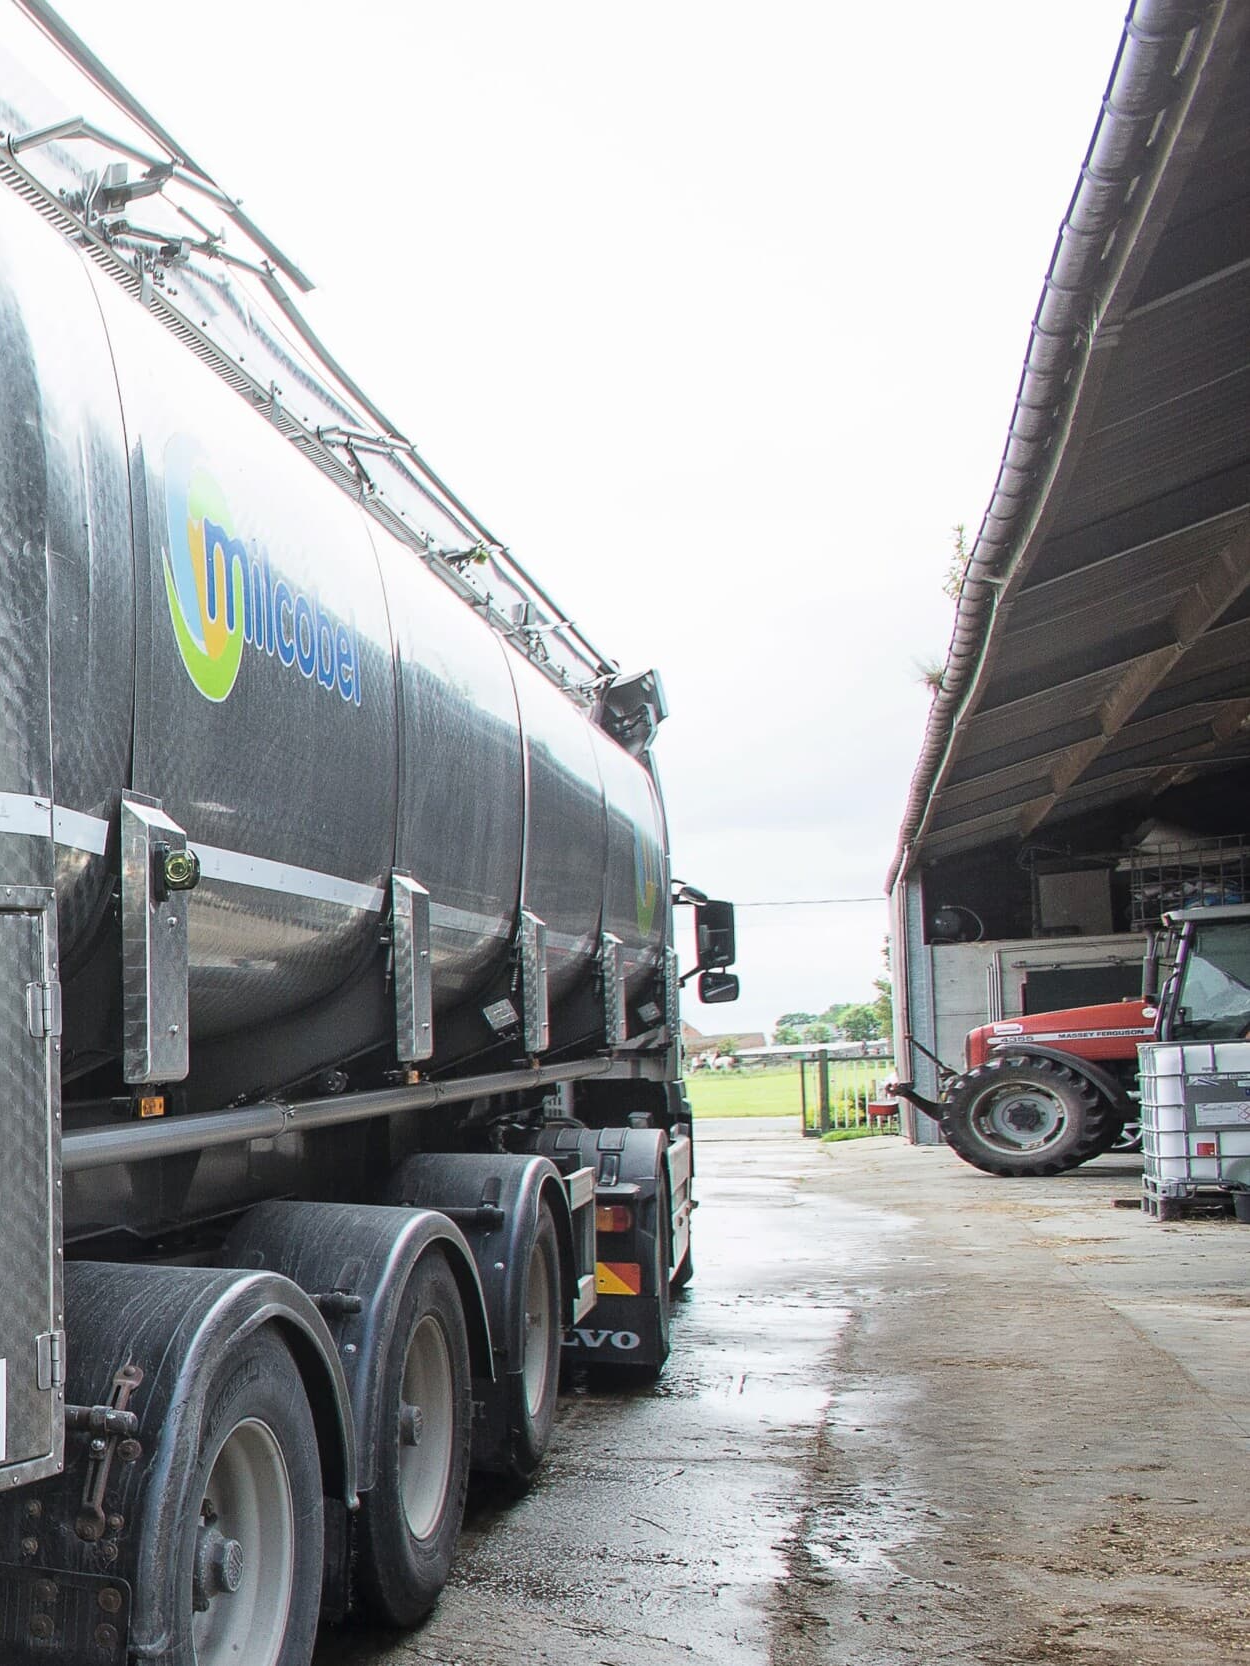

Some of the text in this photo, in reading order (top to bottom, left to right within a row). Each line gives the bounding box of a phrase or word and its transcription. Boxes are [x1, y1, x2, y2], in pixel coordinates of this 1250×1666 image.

[202, 515, 361, 707] milcobel
[1057, 1029, 1146, 1040] MASSEY FERGUSON
[558, 1328, 641, 1350] LVO
